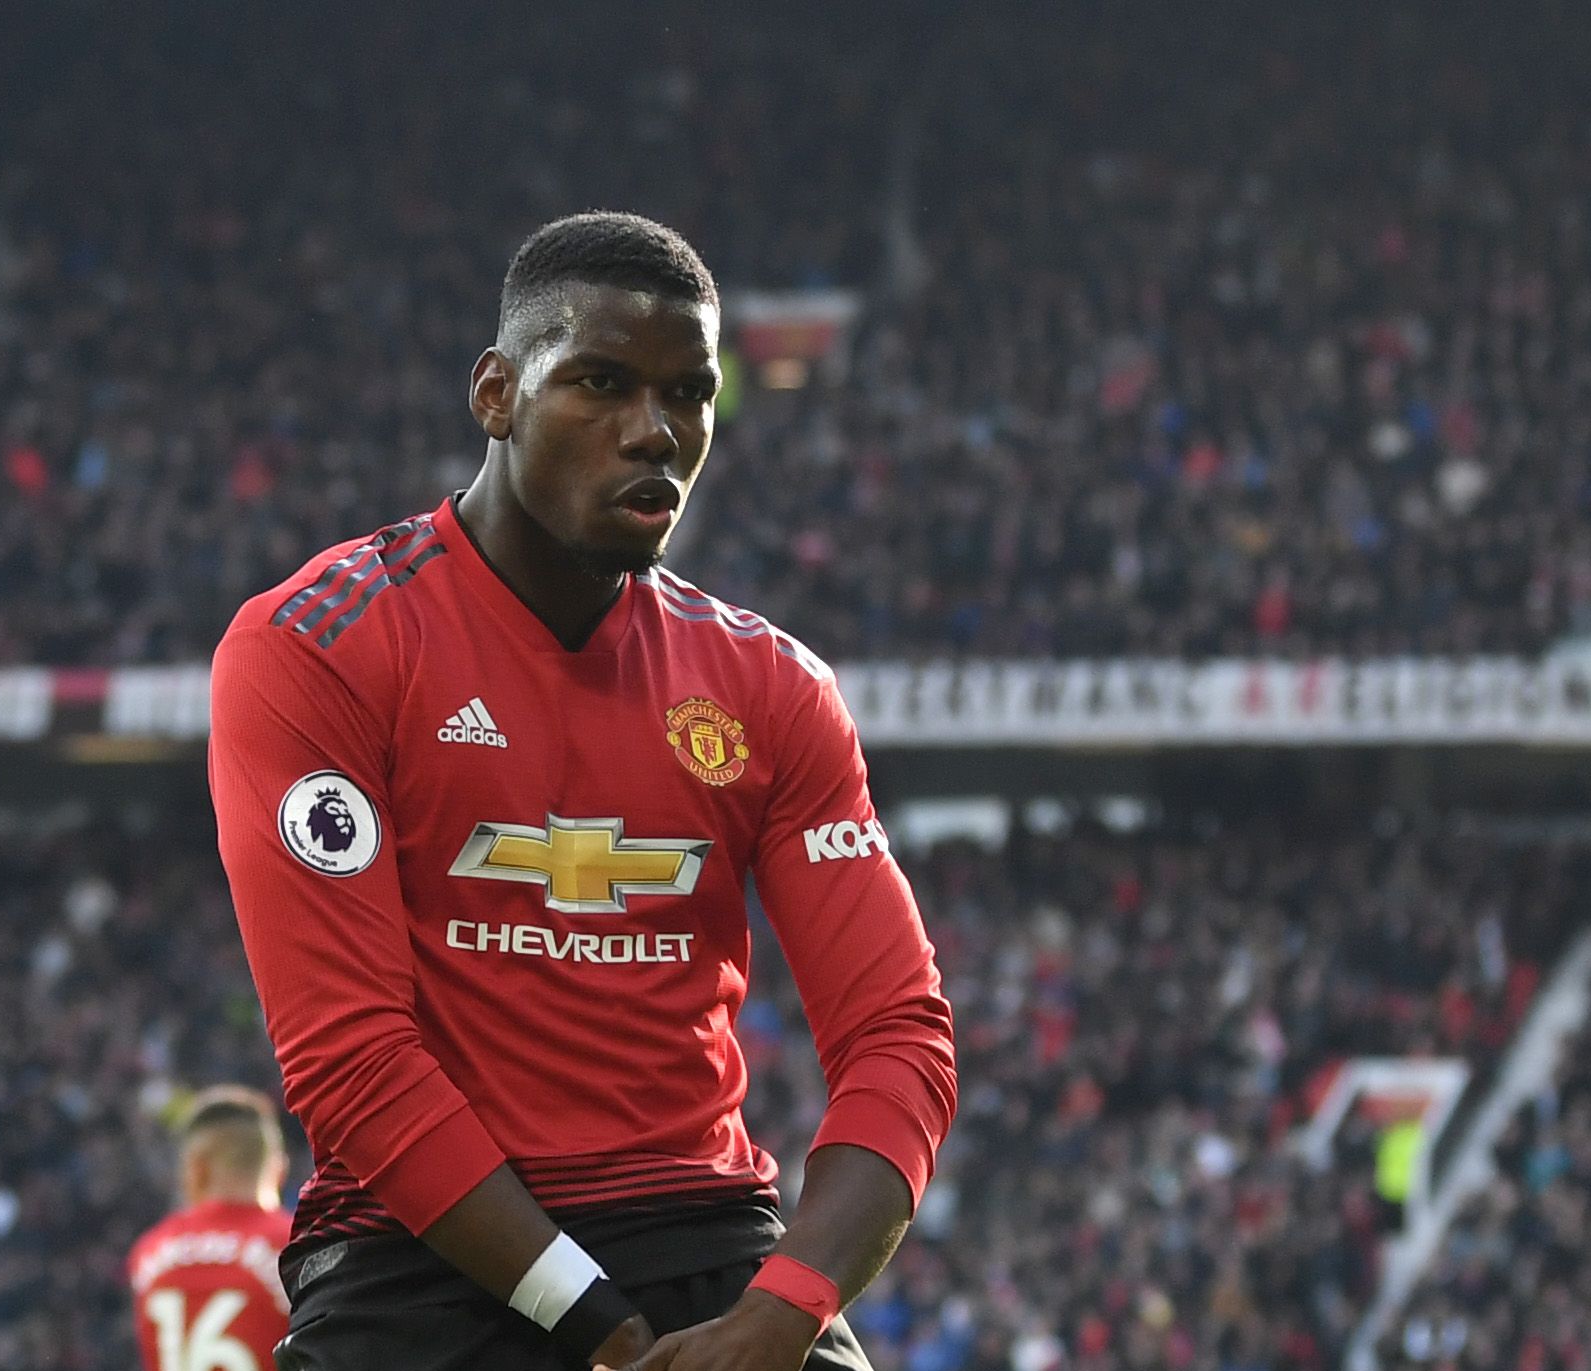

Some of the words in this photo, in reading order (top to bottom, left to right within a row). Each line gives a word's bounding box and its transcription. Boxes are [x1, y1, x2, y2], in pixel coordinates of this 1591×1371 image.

[672, 704, 739, 738] MANCHESTER
[437, 724, 508, 749] adidas
[689, 761, 734, 781] UNITED
[306, 848, 338, 867] League
[446, 919, 695, 964] CHEVROLET
